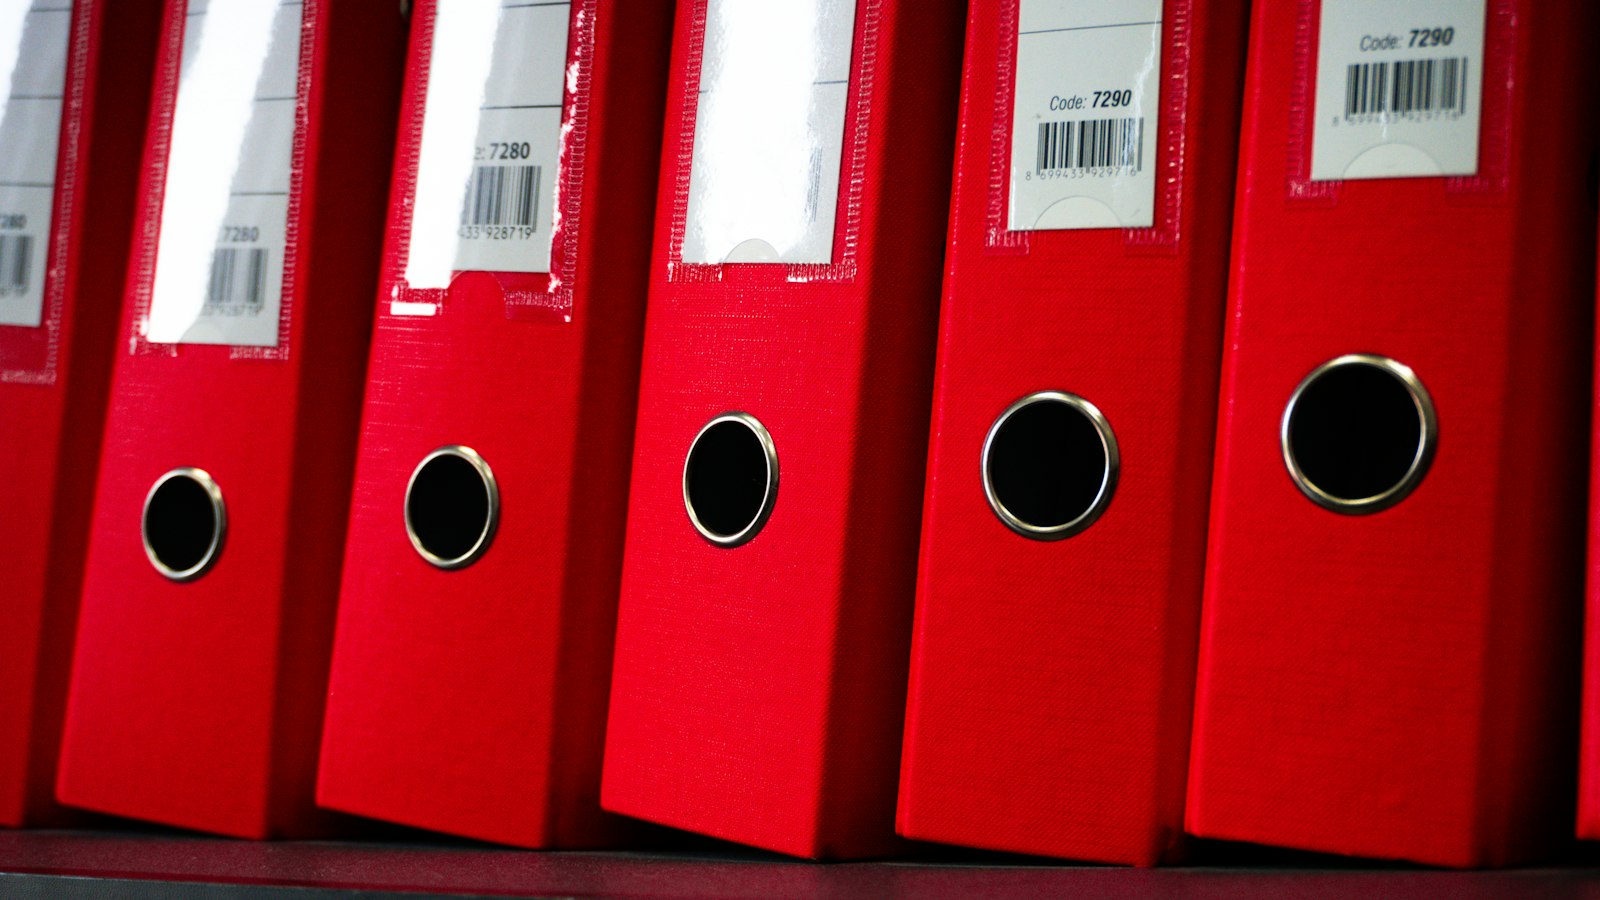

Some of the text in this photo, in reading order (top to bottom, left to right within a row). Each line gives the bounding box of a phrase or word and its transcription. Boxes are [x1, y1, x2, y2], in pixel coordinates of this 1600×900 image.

[1359, 26, 1455, 52] Code: 7290
[1049, 89, 1132, 112] Code: 7290
[489, 142, 531, 160] 7280
[1025, 170, 1032, 181] 8
[1040, 167, 1085, 181] 699433
[223, 225, 260, 242] 7280
[486, 225, 532, 240] 928719
